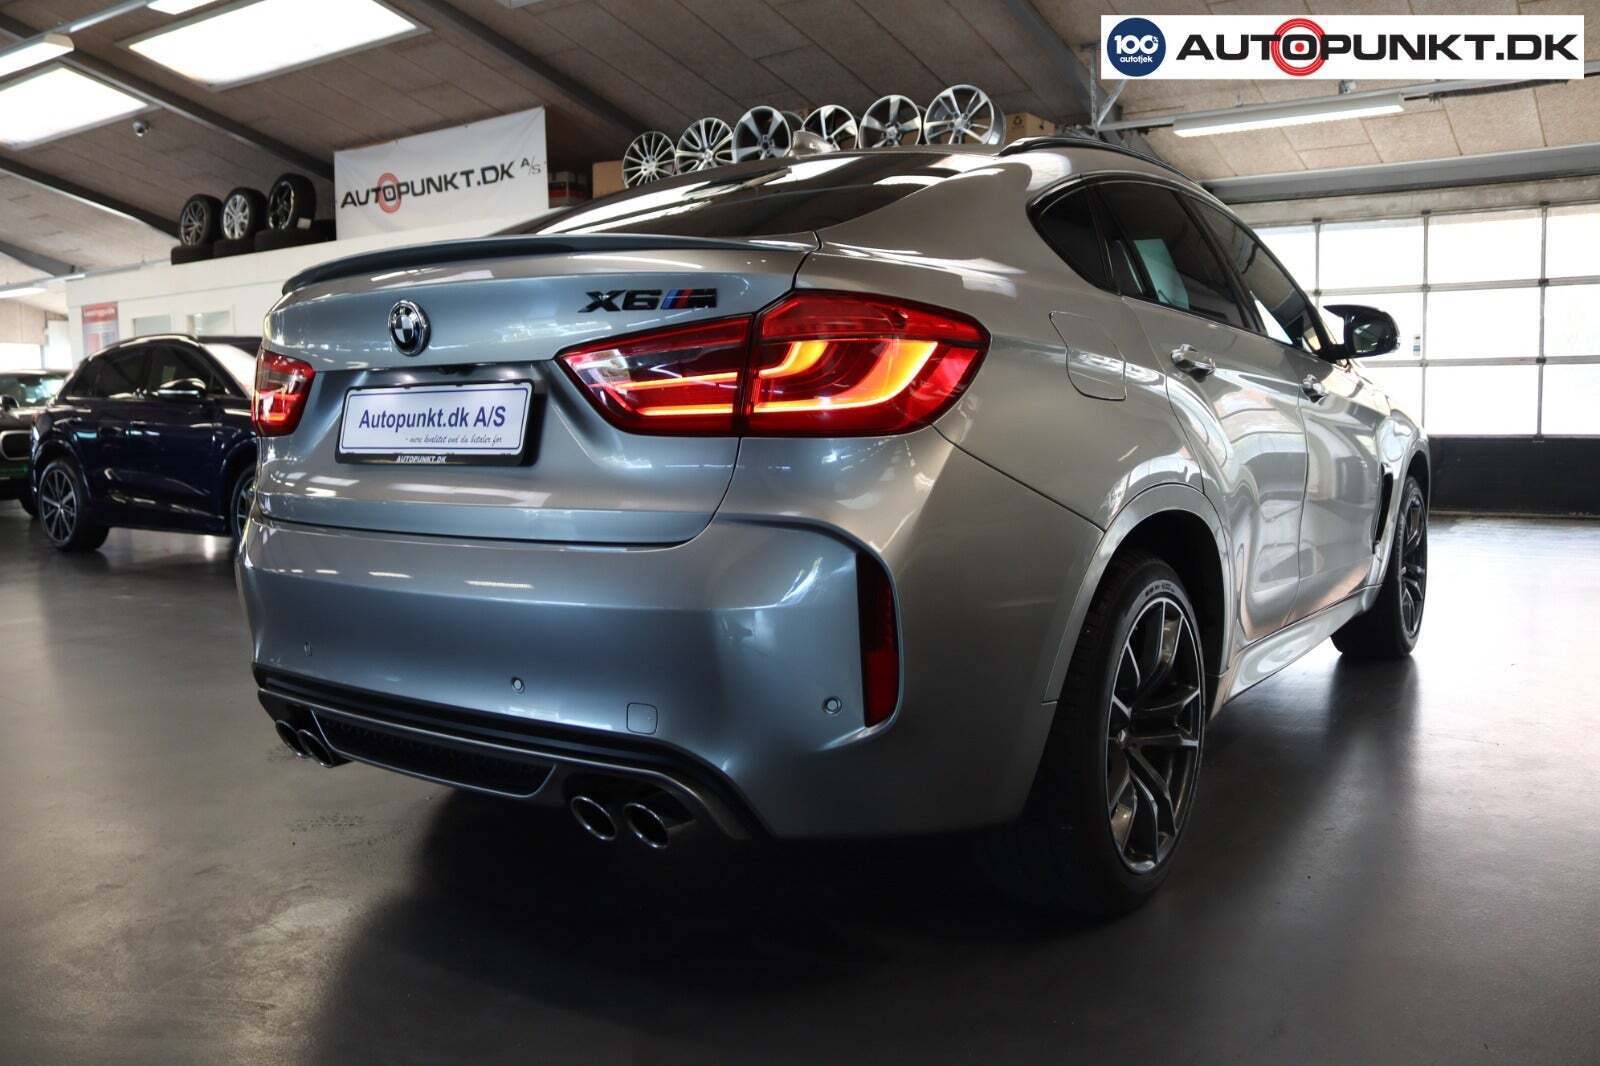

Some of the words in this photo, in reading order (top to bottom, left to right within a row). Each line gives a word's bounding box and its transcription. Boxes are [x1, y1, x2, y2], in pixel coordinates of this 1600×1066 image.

[341, 162, 514, 208] AUTOPUNKT.DK
[358, 408, 469, 432] Autopunkt.dk
[473, 406, 506, 427] A/S
[397, 455, 447, 464] AUTOPUNKT.DK
